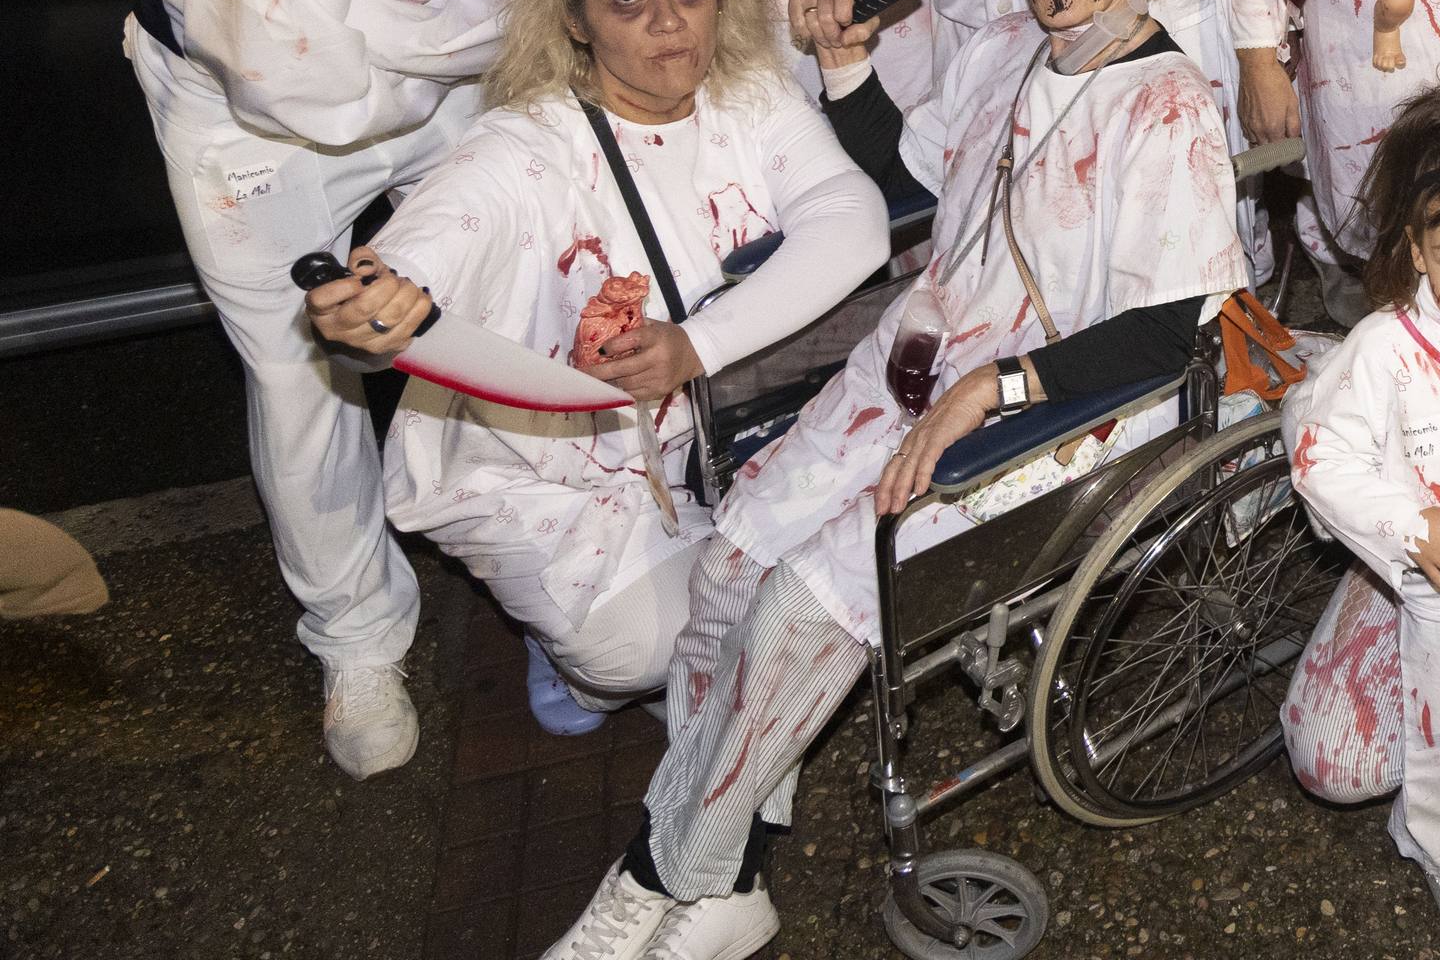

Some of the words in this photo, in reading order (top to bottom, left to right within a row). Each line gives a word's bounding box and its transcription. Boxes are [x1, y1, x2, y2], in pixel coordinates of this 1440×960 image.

[227, 165, 275, 182] Manicomio
[236, 189, 248, 201] La
[1400, 422, 1439, 438] anicomio
